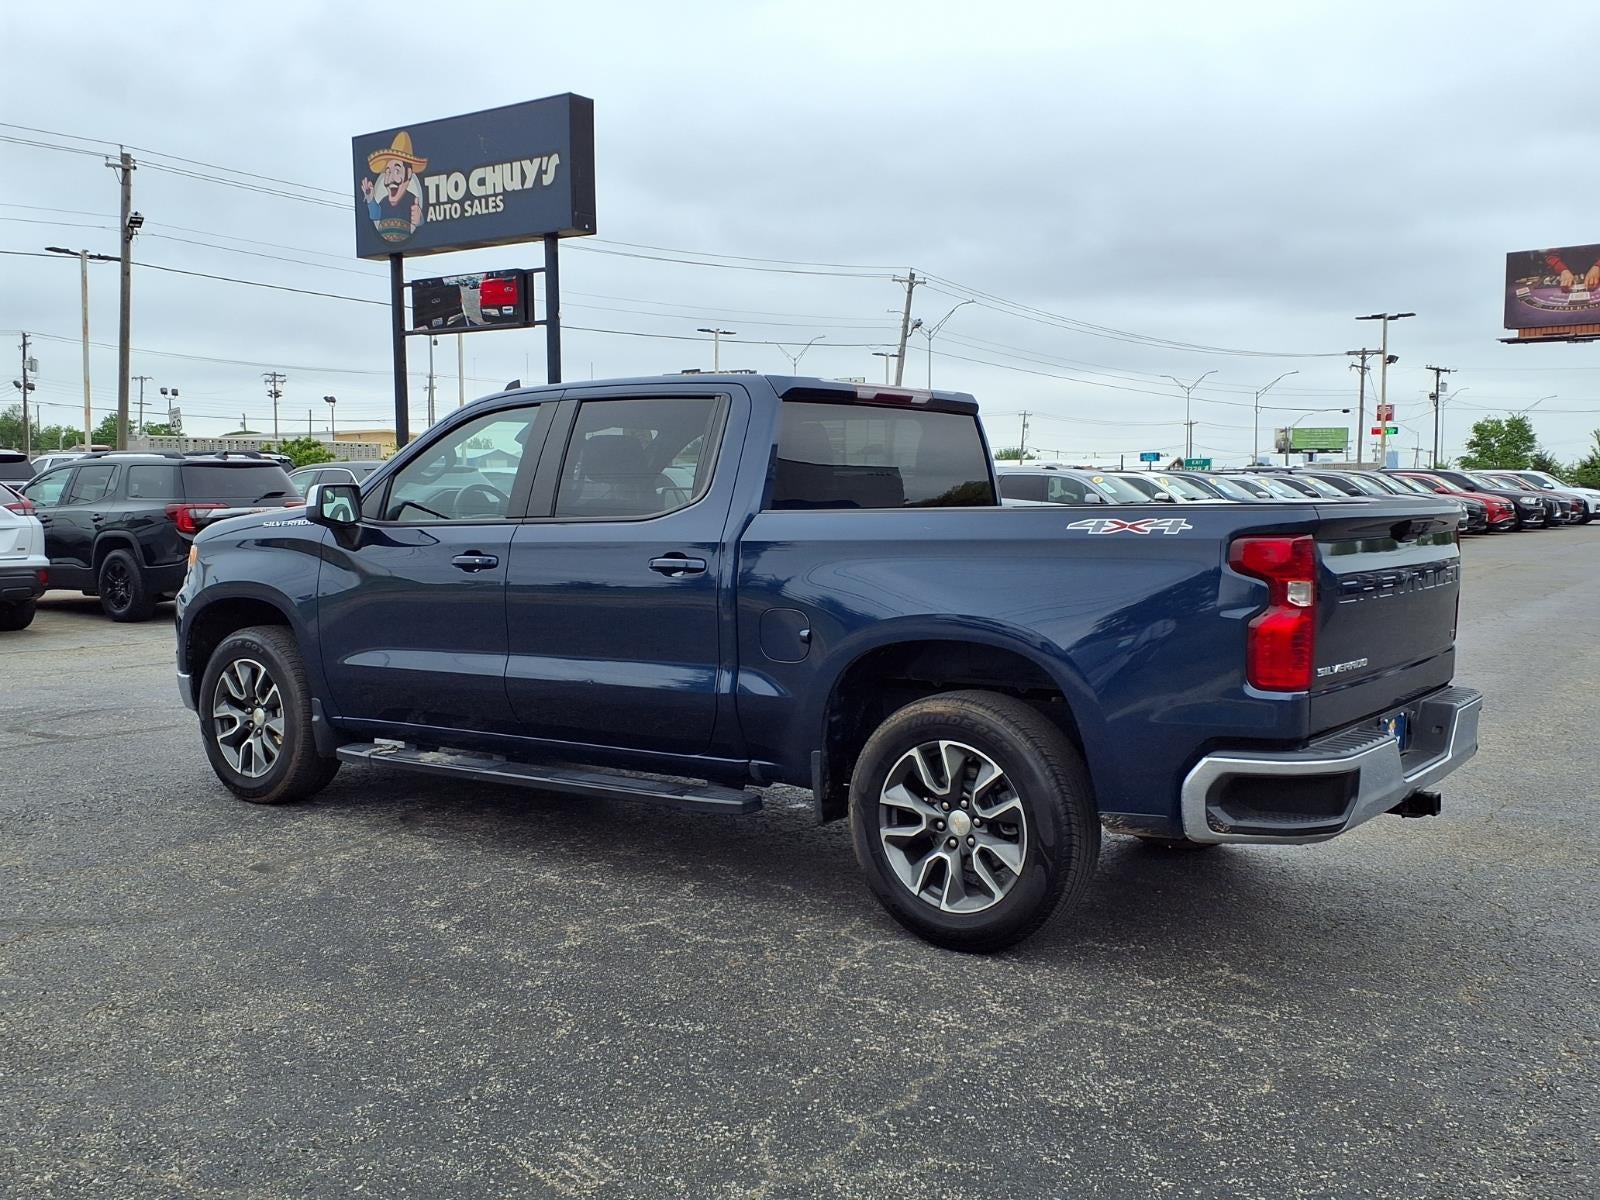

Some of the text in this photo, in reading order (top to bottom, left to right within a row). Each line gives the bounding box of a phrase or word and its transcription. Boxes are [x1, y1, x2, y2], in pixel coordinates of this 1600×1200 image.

[424, 153, 560, 204] TIO CHUY'S
[426, 195, 505, 222] AUTO SALES
[171, 418, 182, 429] 40
[1338, 564, 1460, 604] CHEVROLET
[1316, 657, 1368, 677] SILVERADO
